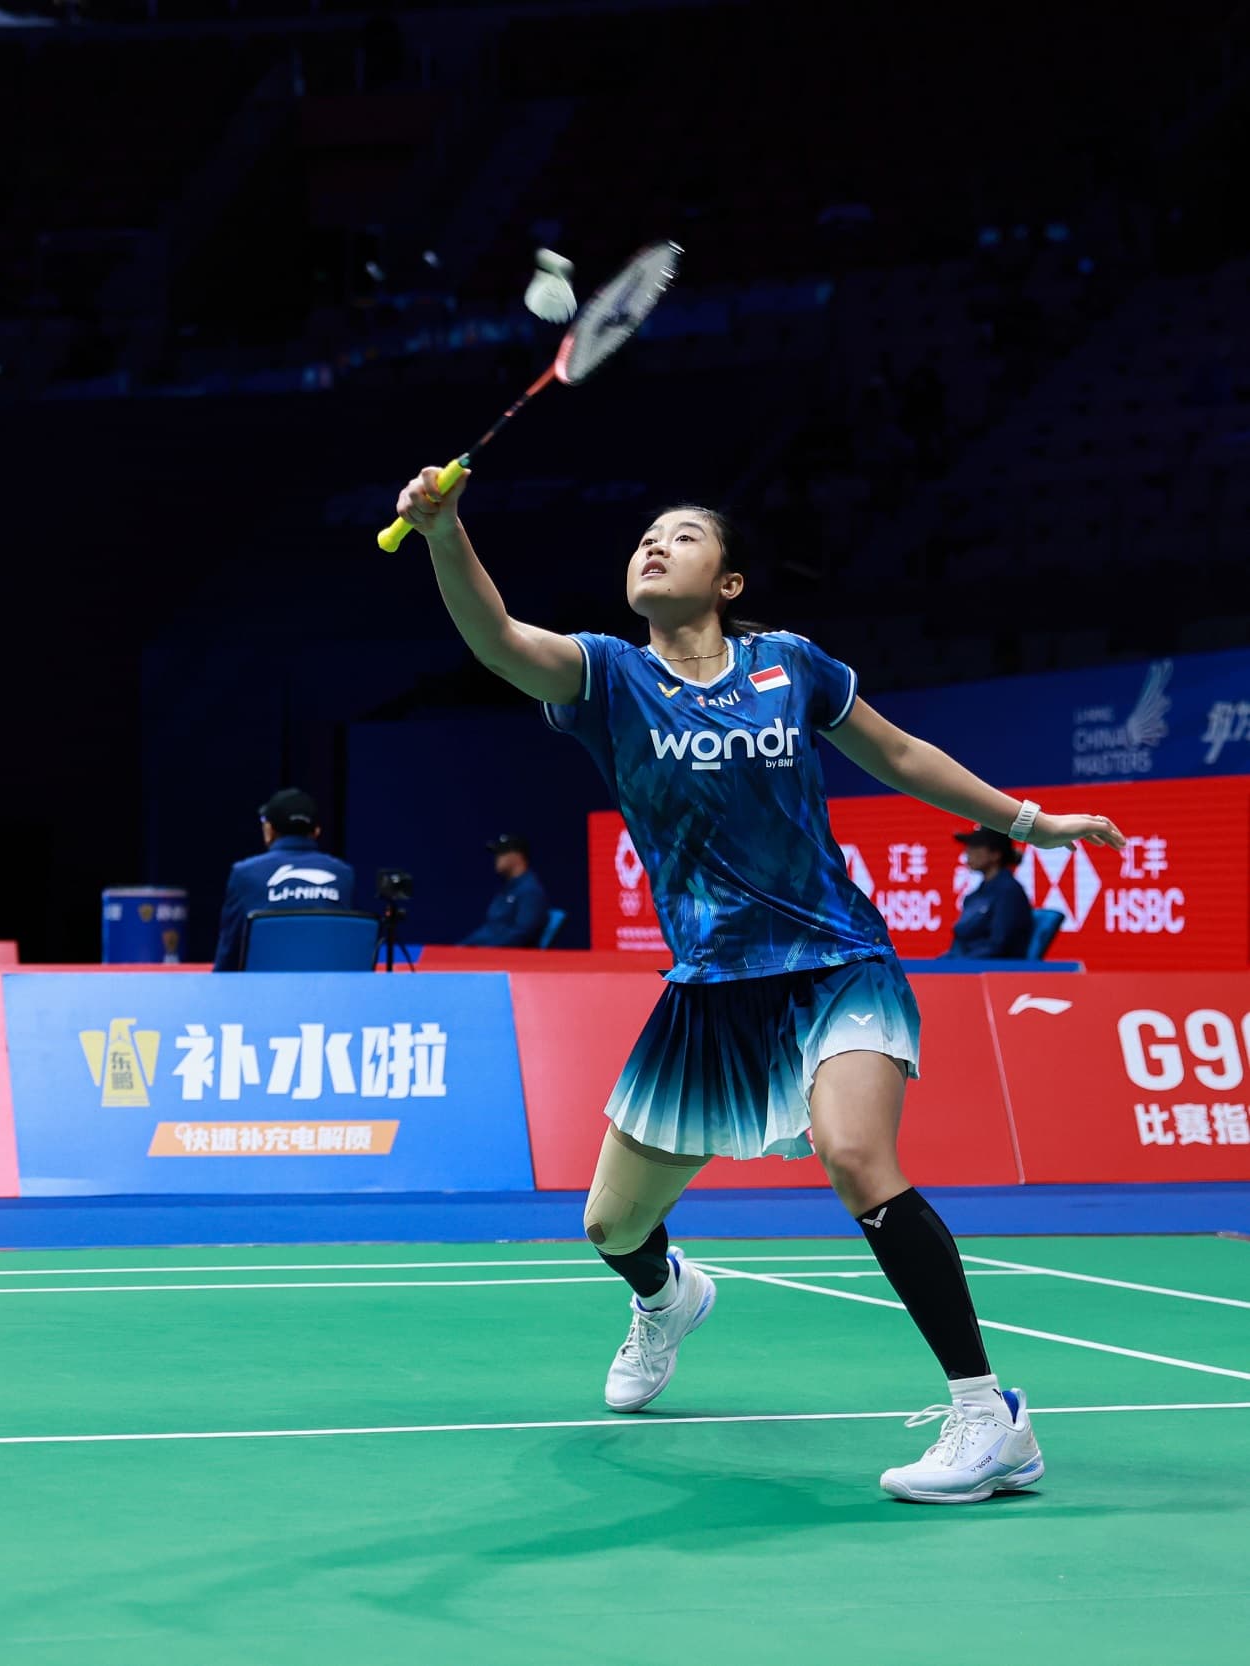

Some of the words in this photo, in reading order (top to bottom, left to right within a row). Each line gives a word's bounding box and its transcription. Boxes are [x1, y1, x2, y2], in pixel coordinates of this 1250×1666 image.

[650, 718, 799, 769] wondr
[766, 760, 777, 769] by
[778, 758, 793, 767] BNI
[888, 843, 928, 883] 汇丰
[1120, 835, 1168, 880] 汇丰
[268, 886, 340, 901] LI-NING
[877, 890, 942, 931] HSBC
[1105, 888, 1185, 933] HSBC
[172, 1023, 448, 1101] 补水啦
[1117, 1008, 1250, 1091] G9
[181, 1125, 372, 1152] 快速补充电解质
[1134, 1103, 1250, 1145] 比赛指
